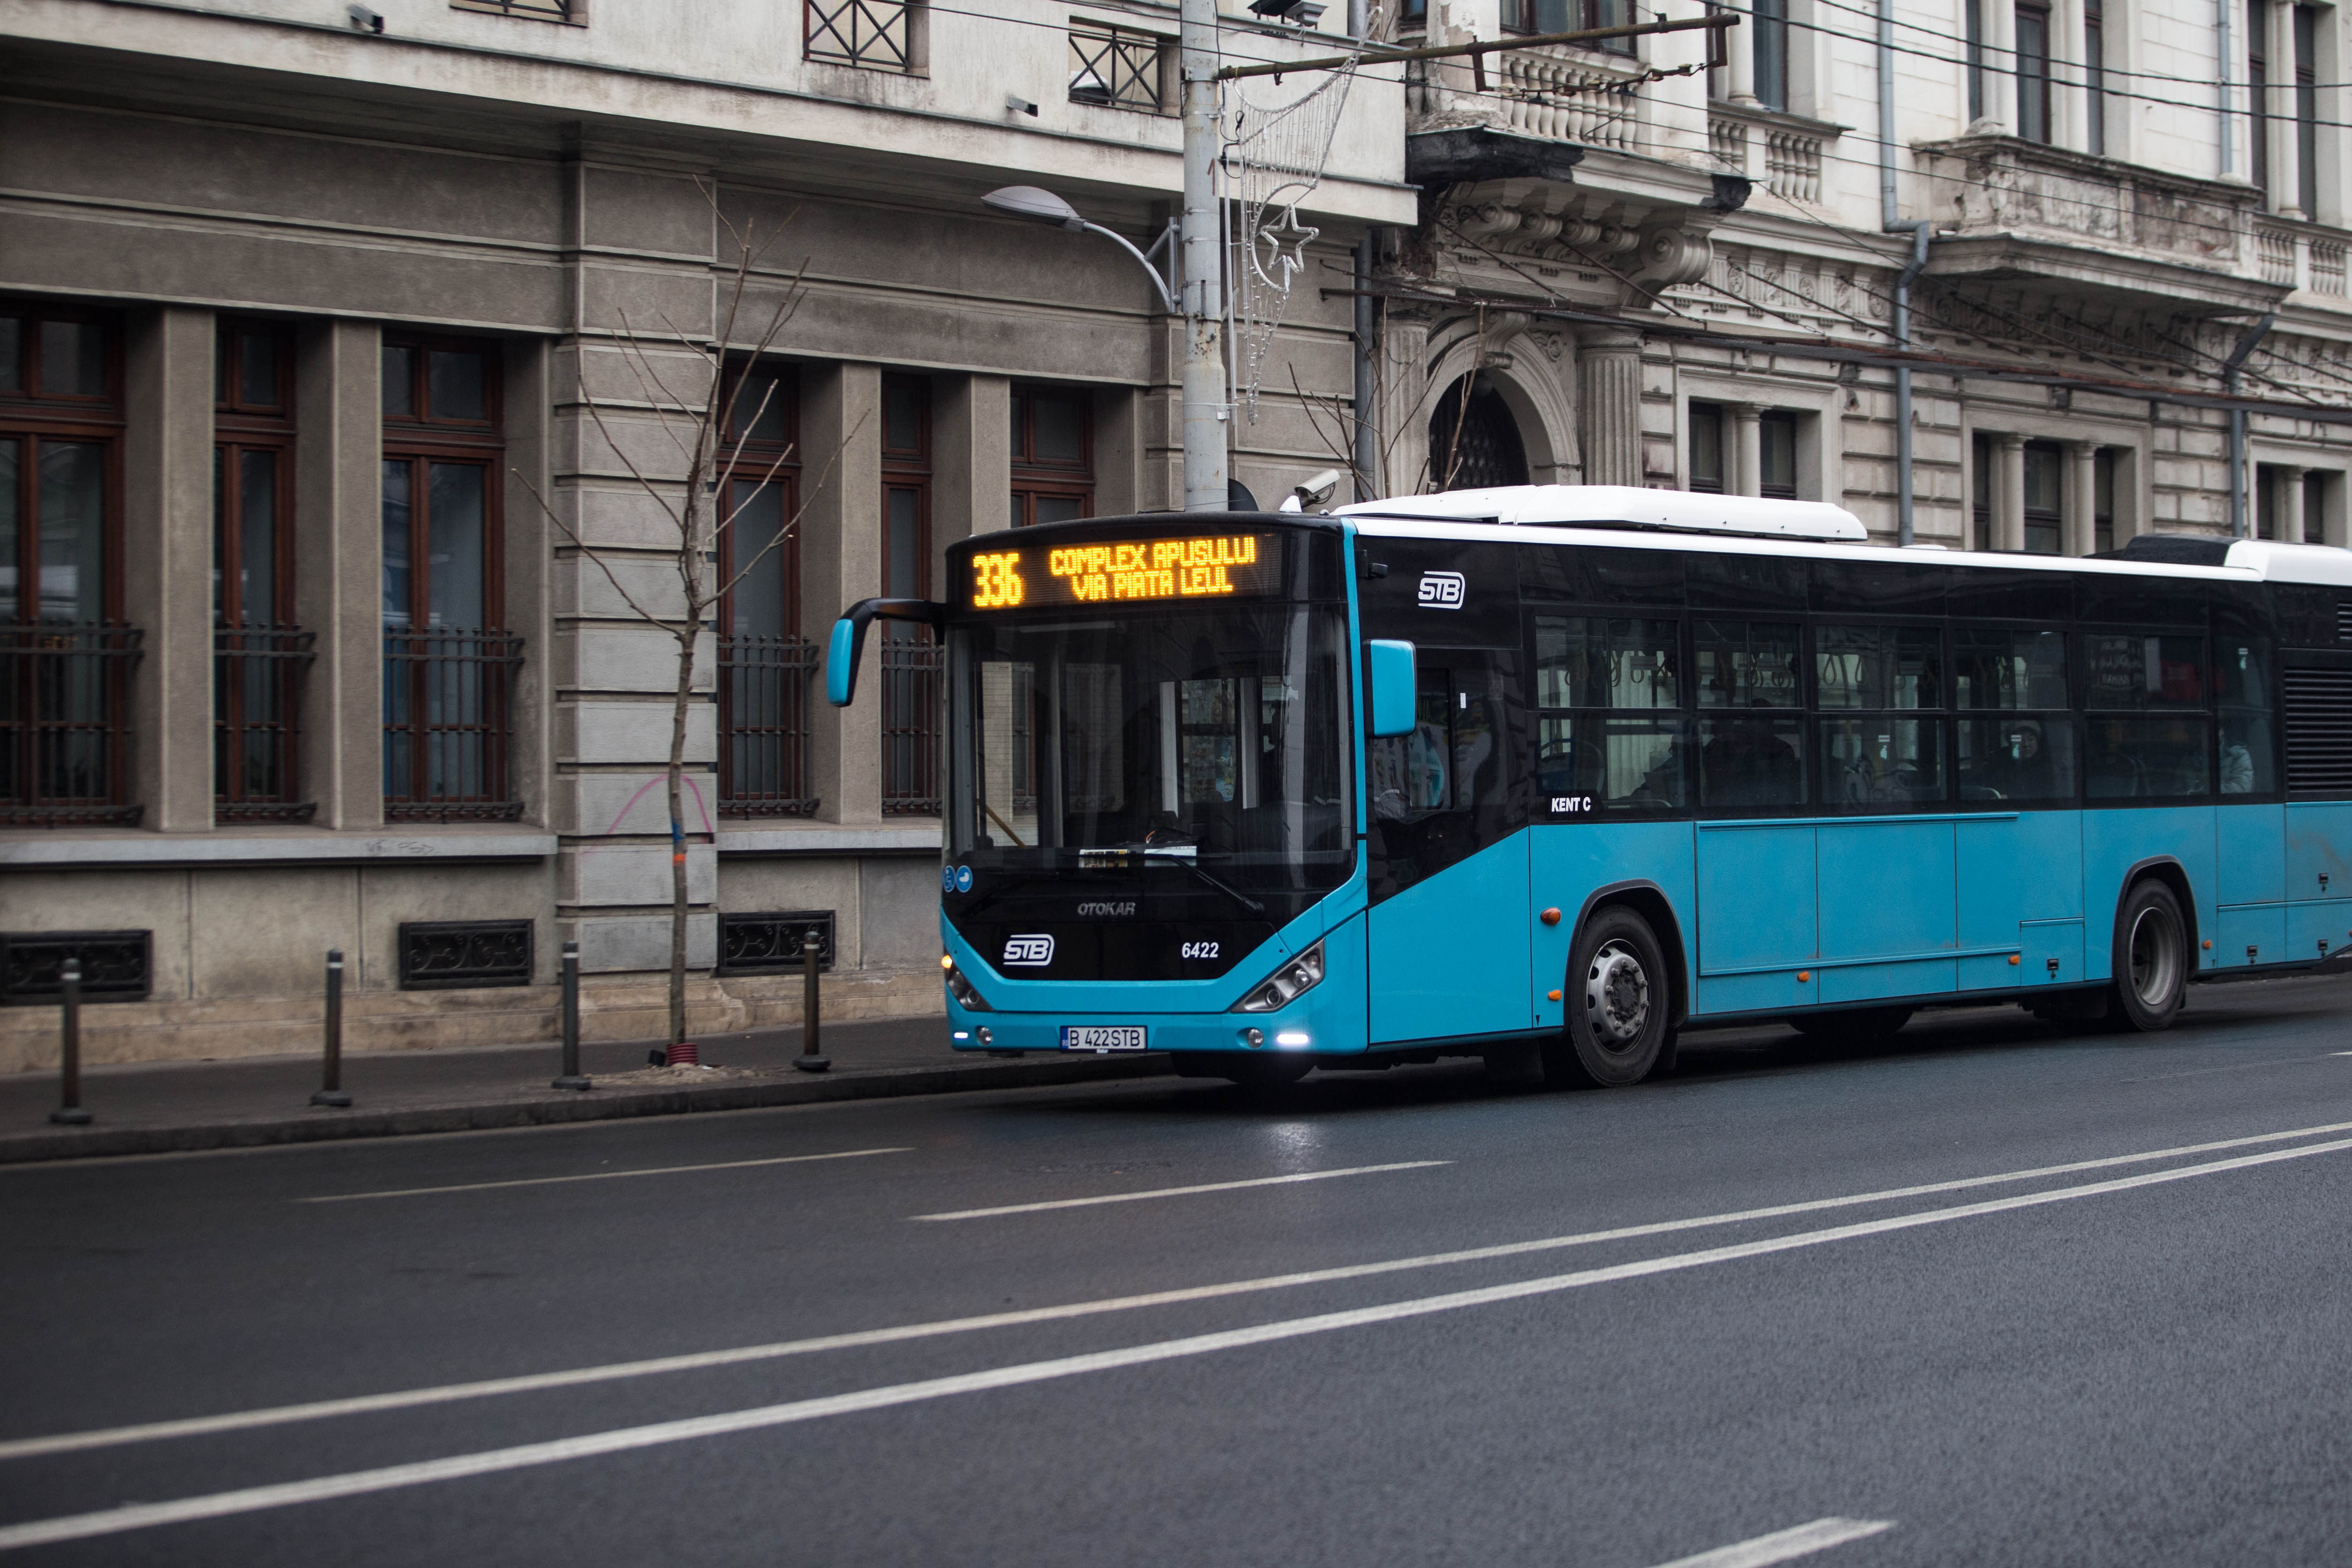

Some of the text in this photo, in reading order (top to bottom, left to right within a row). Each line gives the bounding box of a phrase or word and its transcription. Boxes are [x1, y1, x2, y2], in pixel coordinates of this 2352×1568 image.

[1050, 536, 1256, 575] COMPLEX APUSULUI
[973, 553, 1021, 606] 336
[1072, 566, 1233, 600] VIA PIATA LEUL
[1418, 577, 1461, 602] STB
[1551, 796, 1591, 812] KENT C
[1077, 902, 1136, 915] OTOKAR
[1003, 940, 1050, 960] STB
[1182, 942, 1219, 958] 6422
[1070, 1030, 1079, 1047] B
